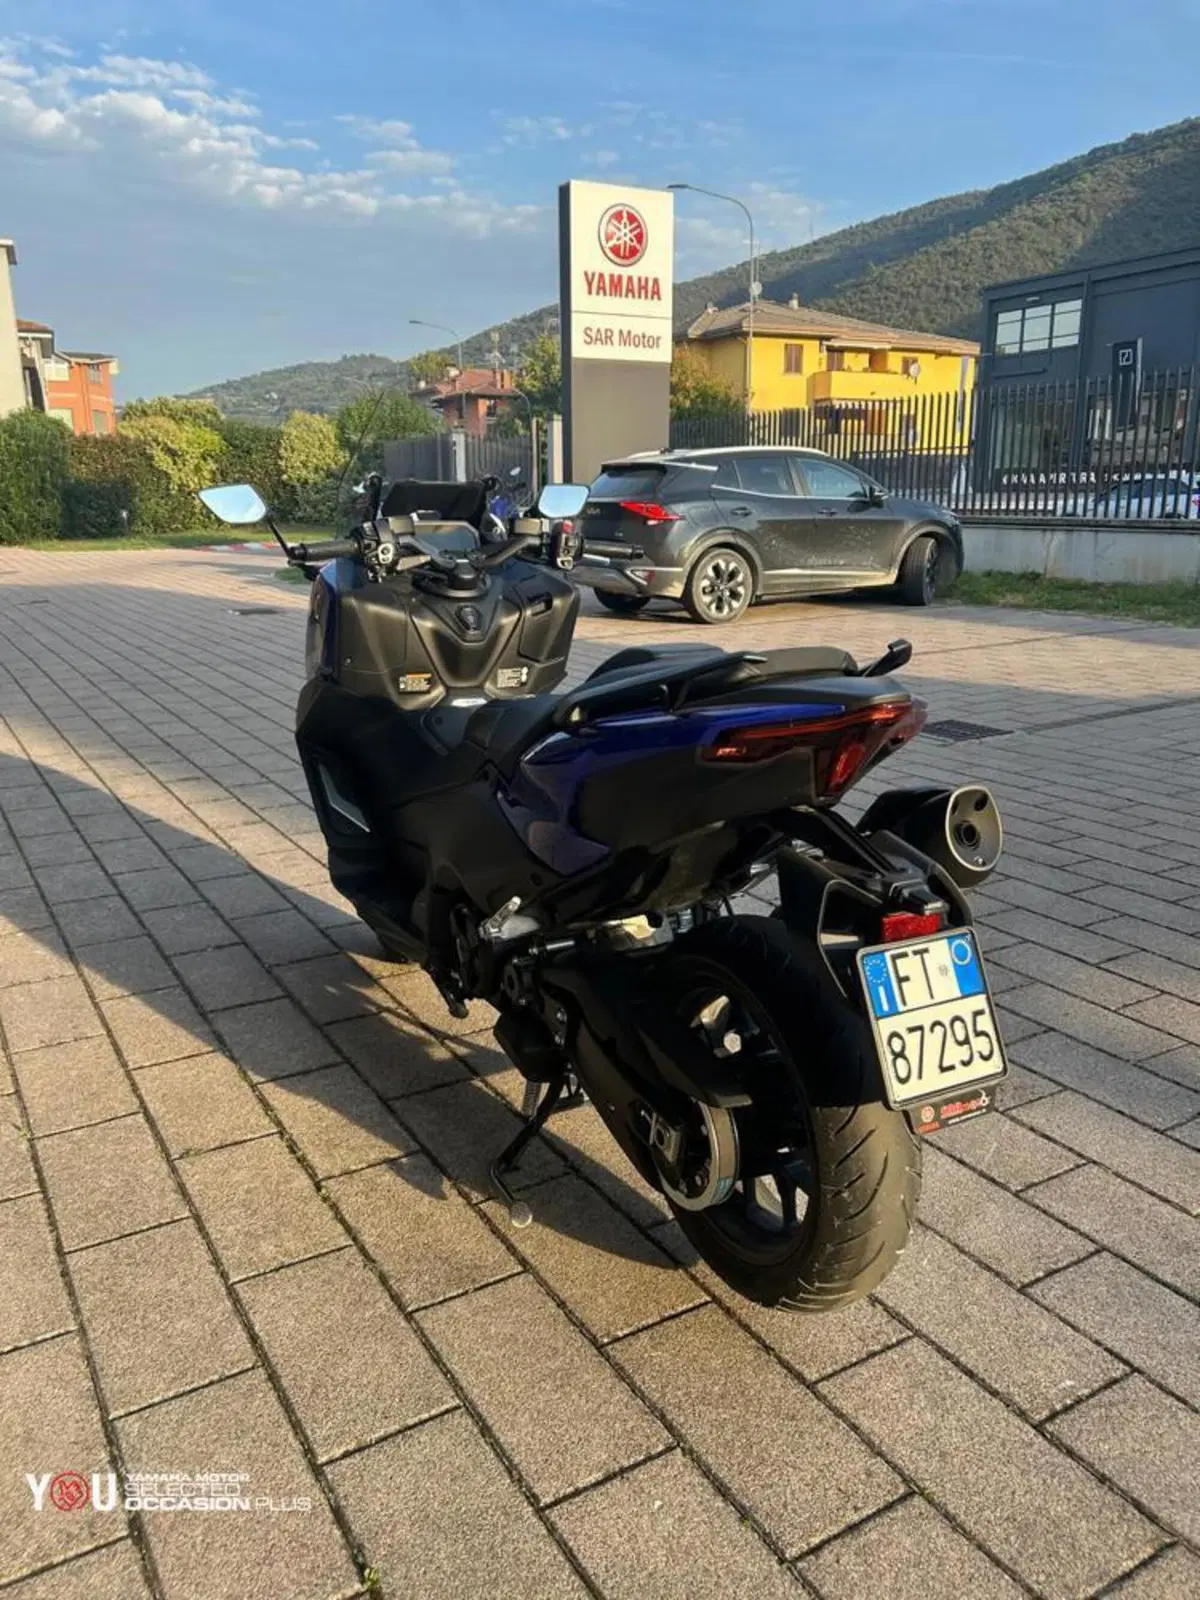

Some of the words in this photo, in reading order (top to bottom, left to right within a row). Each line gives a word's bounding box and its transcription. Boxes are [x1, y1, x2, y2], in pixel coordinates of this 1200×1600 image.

[583, 270, 662, 301] YAMAHA
[583, 326, 614, 346] SAR
[618, 329, 662, 349] Motor
[890, 948, 934, 1007] FT
[887, 1009, 994, 1085] 87295
